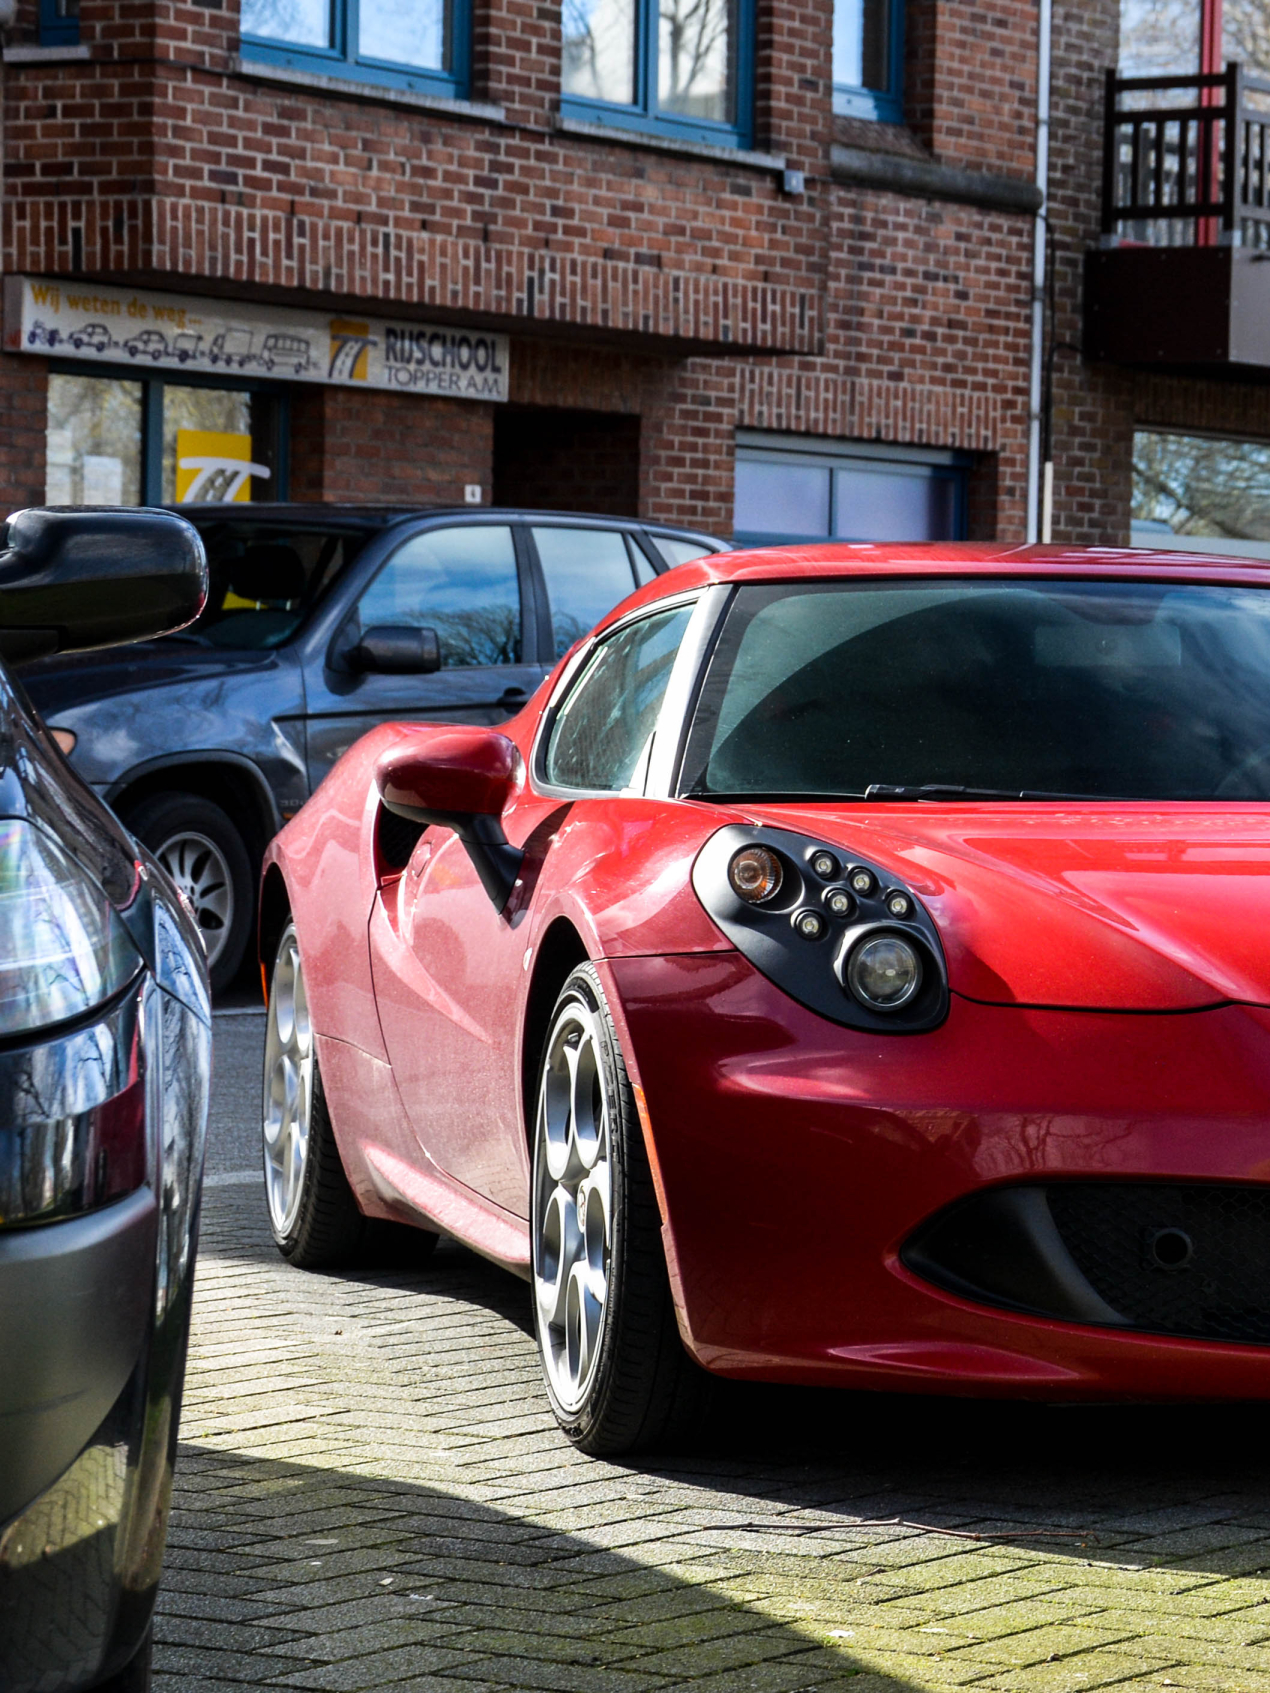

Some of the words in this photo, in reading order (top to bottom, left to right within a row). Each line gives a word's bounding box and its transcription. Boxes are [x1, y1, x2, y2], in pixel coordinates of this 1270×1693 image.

[30, 283, 61, 315] Wij
[66, 293, 121, 316] weten
[127, 297, 147, 319] de
[384, 326, 502, 374] RIJSCHOOL
[384, 364, 462, 391] TOPPER
